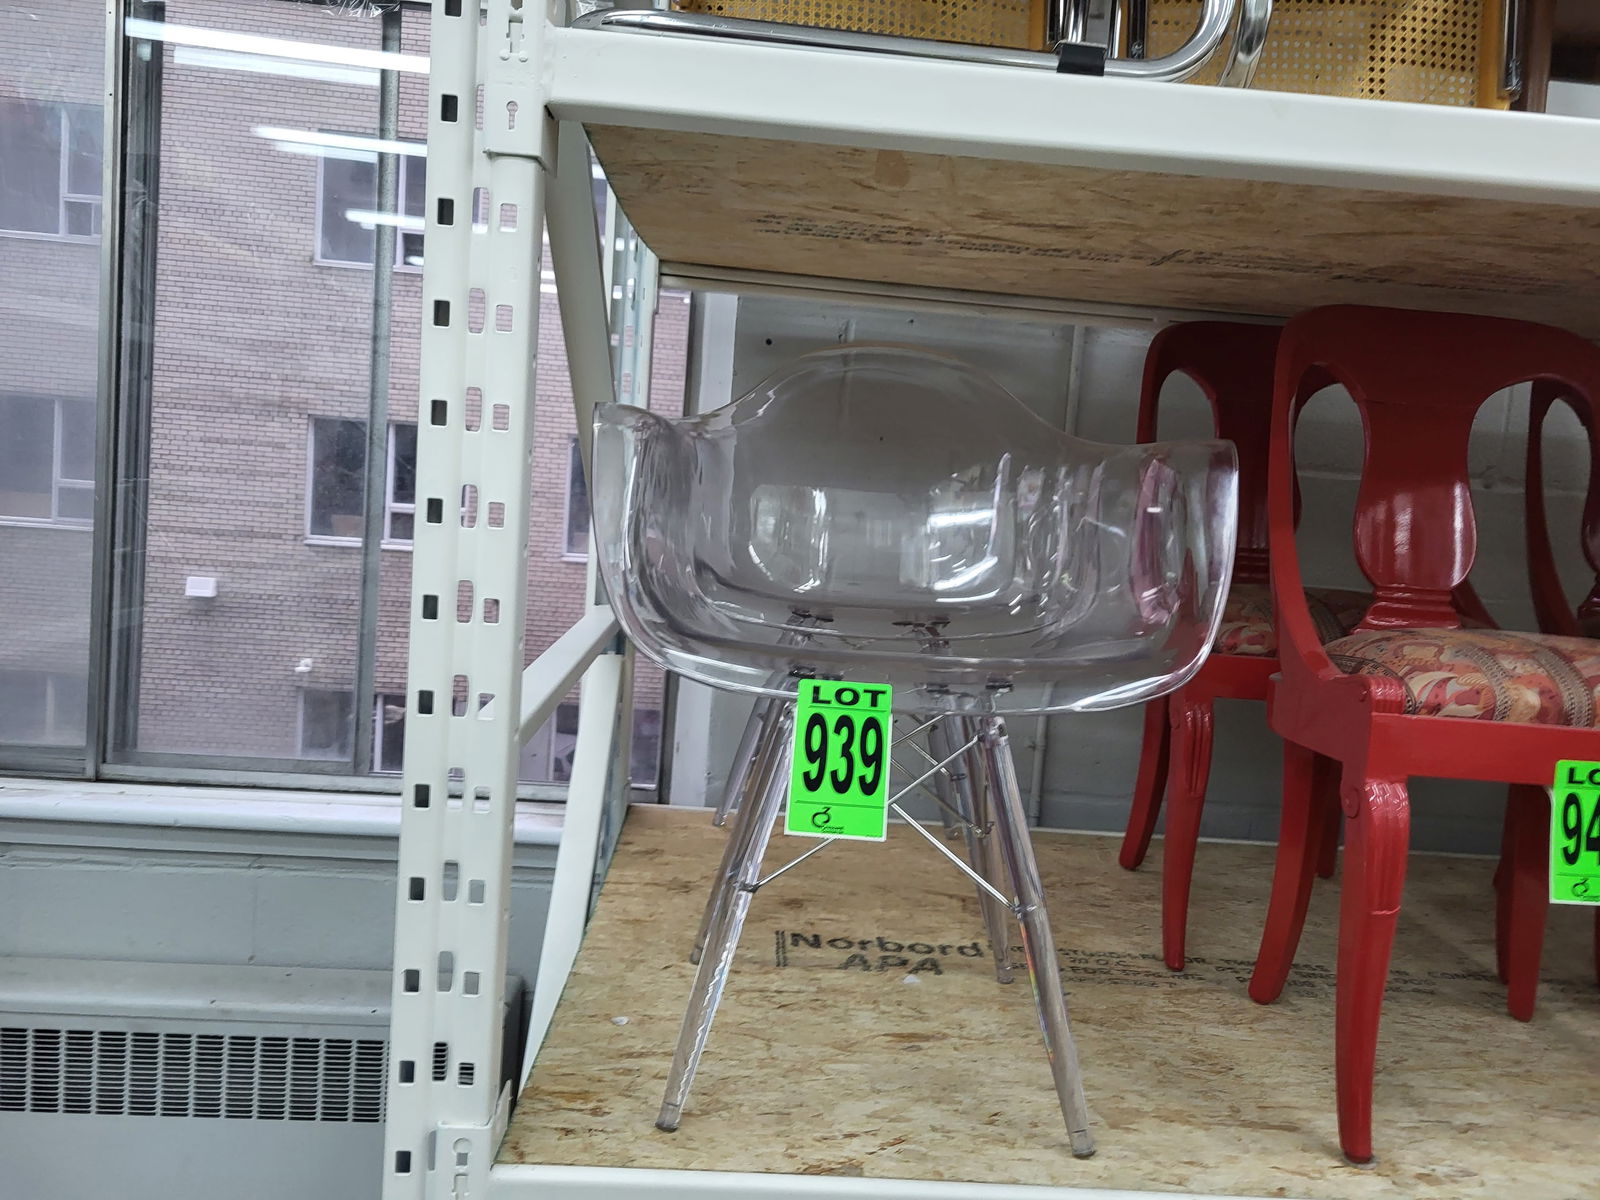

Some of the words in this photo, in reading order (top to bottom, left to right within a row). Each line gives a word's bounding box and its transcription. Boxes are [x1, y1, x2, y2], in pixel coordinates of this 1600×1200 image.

[811, 685, 888, 708] LOT
[802, 712, 884, 796] 939
[790, 932, 984, 958] Norbord
[837, 953, 943, 976] APA
